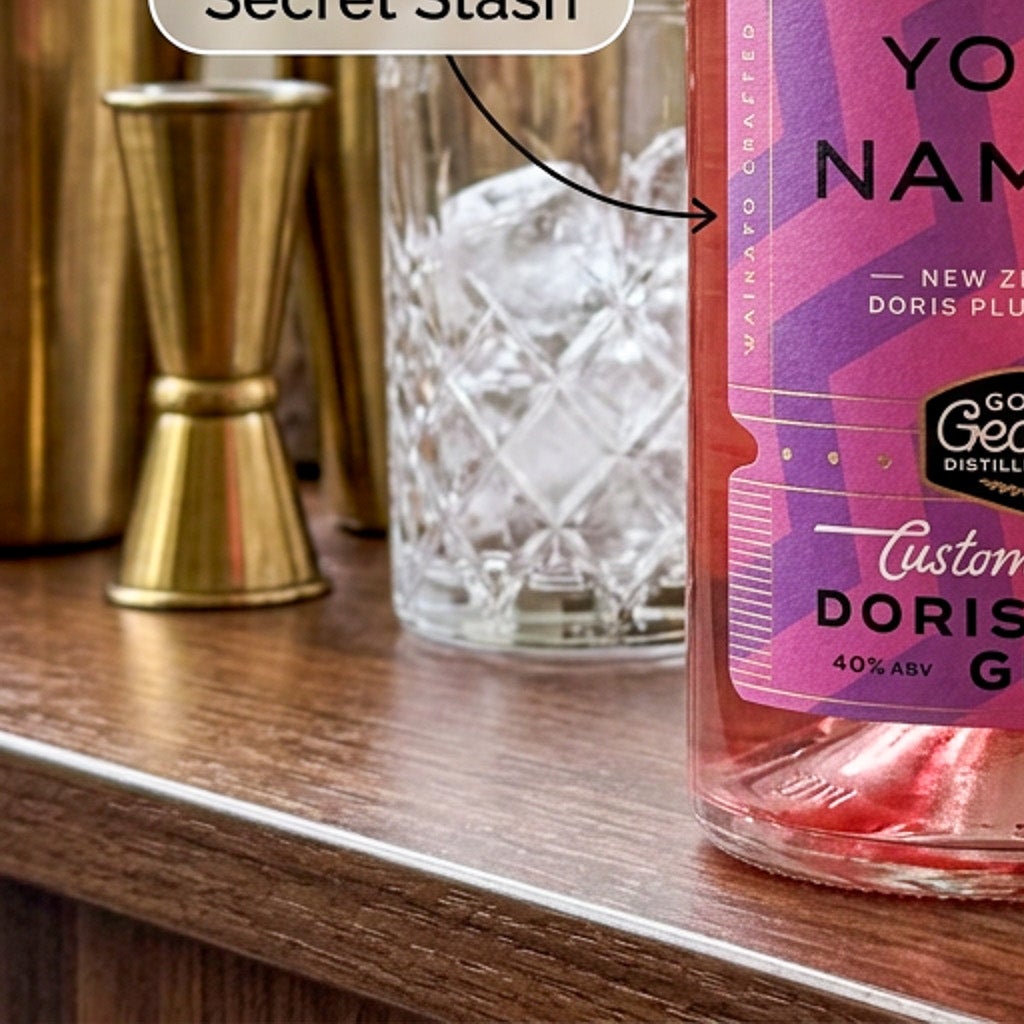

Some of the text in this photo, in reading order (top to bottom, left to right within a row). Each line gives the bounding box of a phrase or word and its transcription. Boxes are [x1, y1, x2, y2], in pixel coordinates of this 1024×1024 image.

[921, 269, 986, 288] NEW
[868, 295, 957, 316] DORIS
[832, 654, 885, 676] 40%
